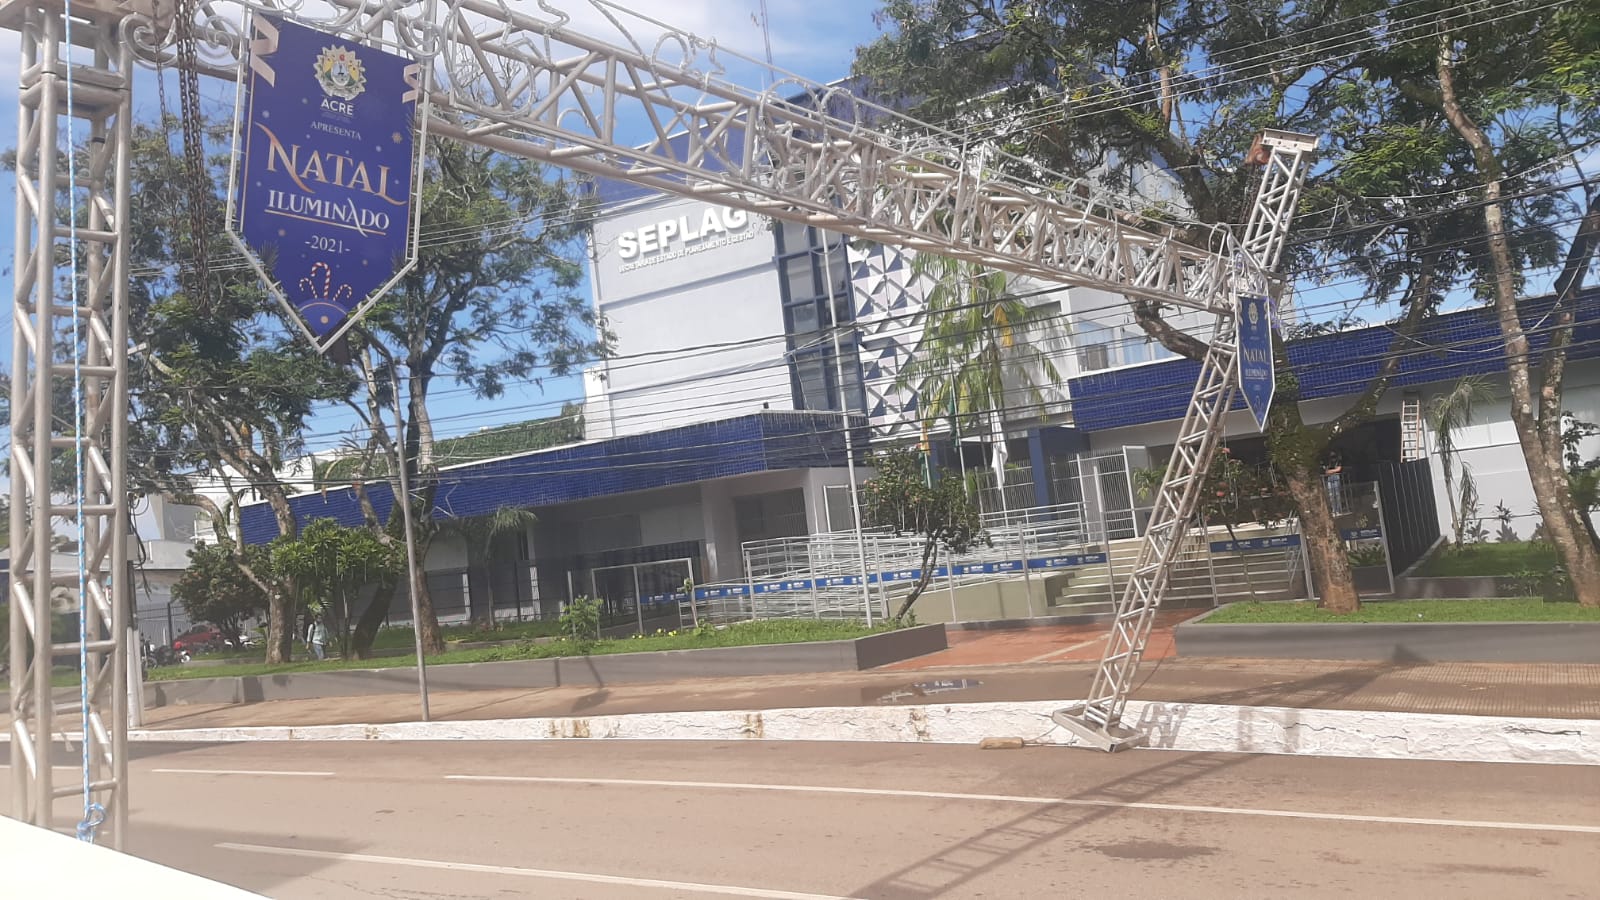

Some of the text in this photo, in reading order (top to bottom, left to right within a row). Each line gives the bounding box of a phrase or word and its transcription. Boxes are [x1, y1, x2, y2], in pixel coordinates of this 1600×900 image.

[320, 98, 354, 115] ACRE
[311, 121, 362, 141] APRESENTA
[255, 122, 407, 205] NATAL
[268, 190, 389, 237] ILUMINADO
[618, 206, 748, 259] SEPLAG
[1242, 343, 1270, 366] NATAL
